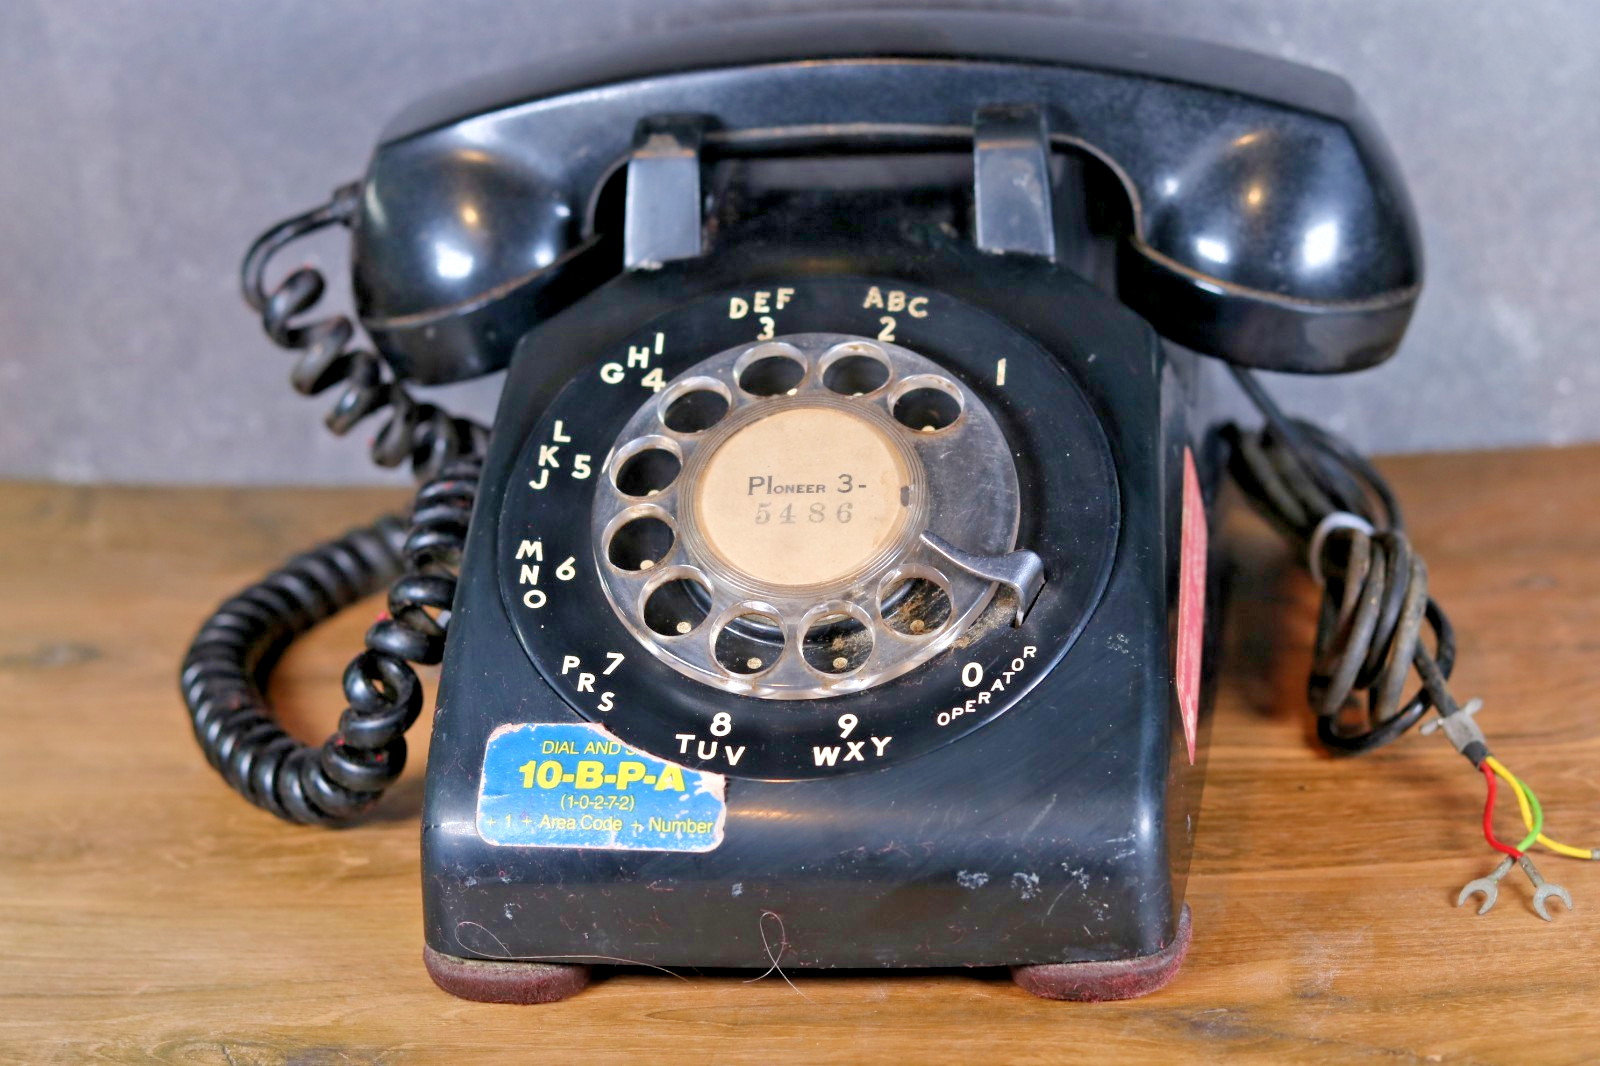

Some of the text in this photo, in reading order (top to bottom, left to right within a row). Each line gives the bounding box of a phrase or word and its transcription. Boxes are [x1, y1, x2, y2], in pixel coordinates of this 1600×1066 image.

[729, 287, 795, 320] DEF
[863, 286, 929, 318] ABC
[757, 317, 775, 341] 3
[877, 316, 896, 342] 2
[600, 332, 665, 384] GHI
[641, 367, 666, 393] 4
[571, 454, 591, 480] 5
[754, 501, 854, 525] 5486
[555, 556, 576, 581] 6
[602, 652, 625, 676] 7
[561, 655, 616, 712] PRS
[936, 645, 1037, 727] OPERATOR
[710, 712, 732, 737] 8
[837, 713, 859, 739] 9
[541, 740, 580, 755] DIAL
[583, 741, 622, 755] AND
[675, 733, 746, 766] TUV
[813, 736, 893, 767] WXY
[518, 760, 686, 792] 10-B-P-A
[560, 794, 635, 812] (1-0-2-7-2)
[539, 815, 576, 830] Area
[580, 814, 623, 831] Code
[649, 817, 713, 834] Number
